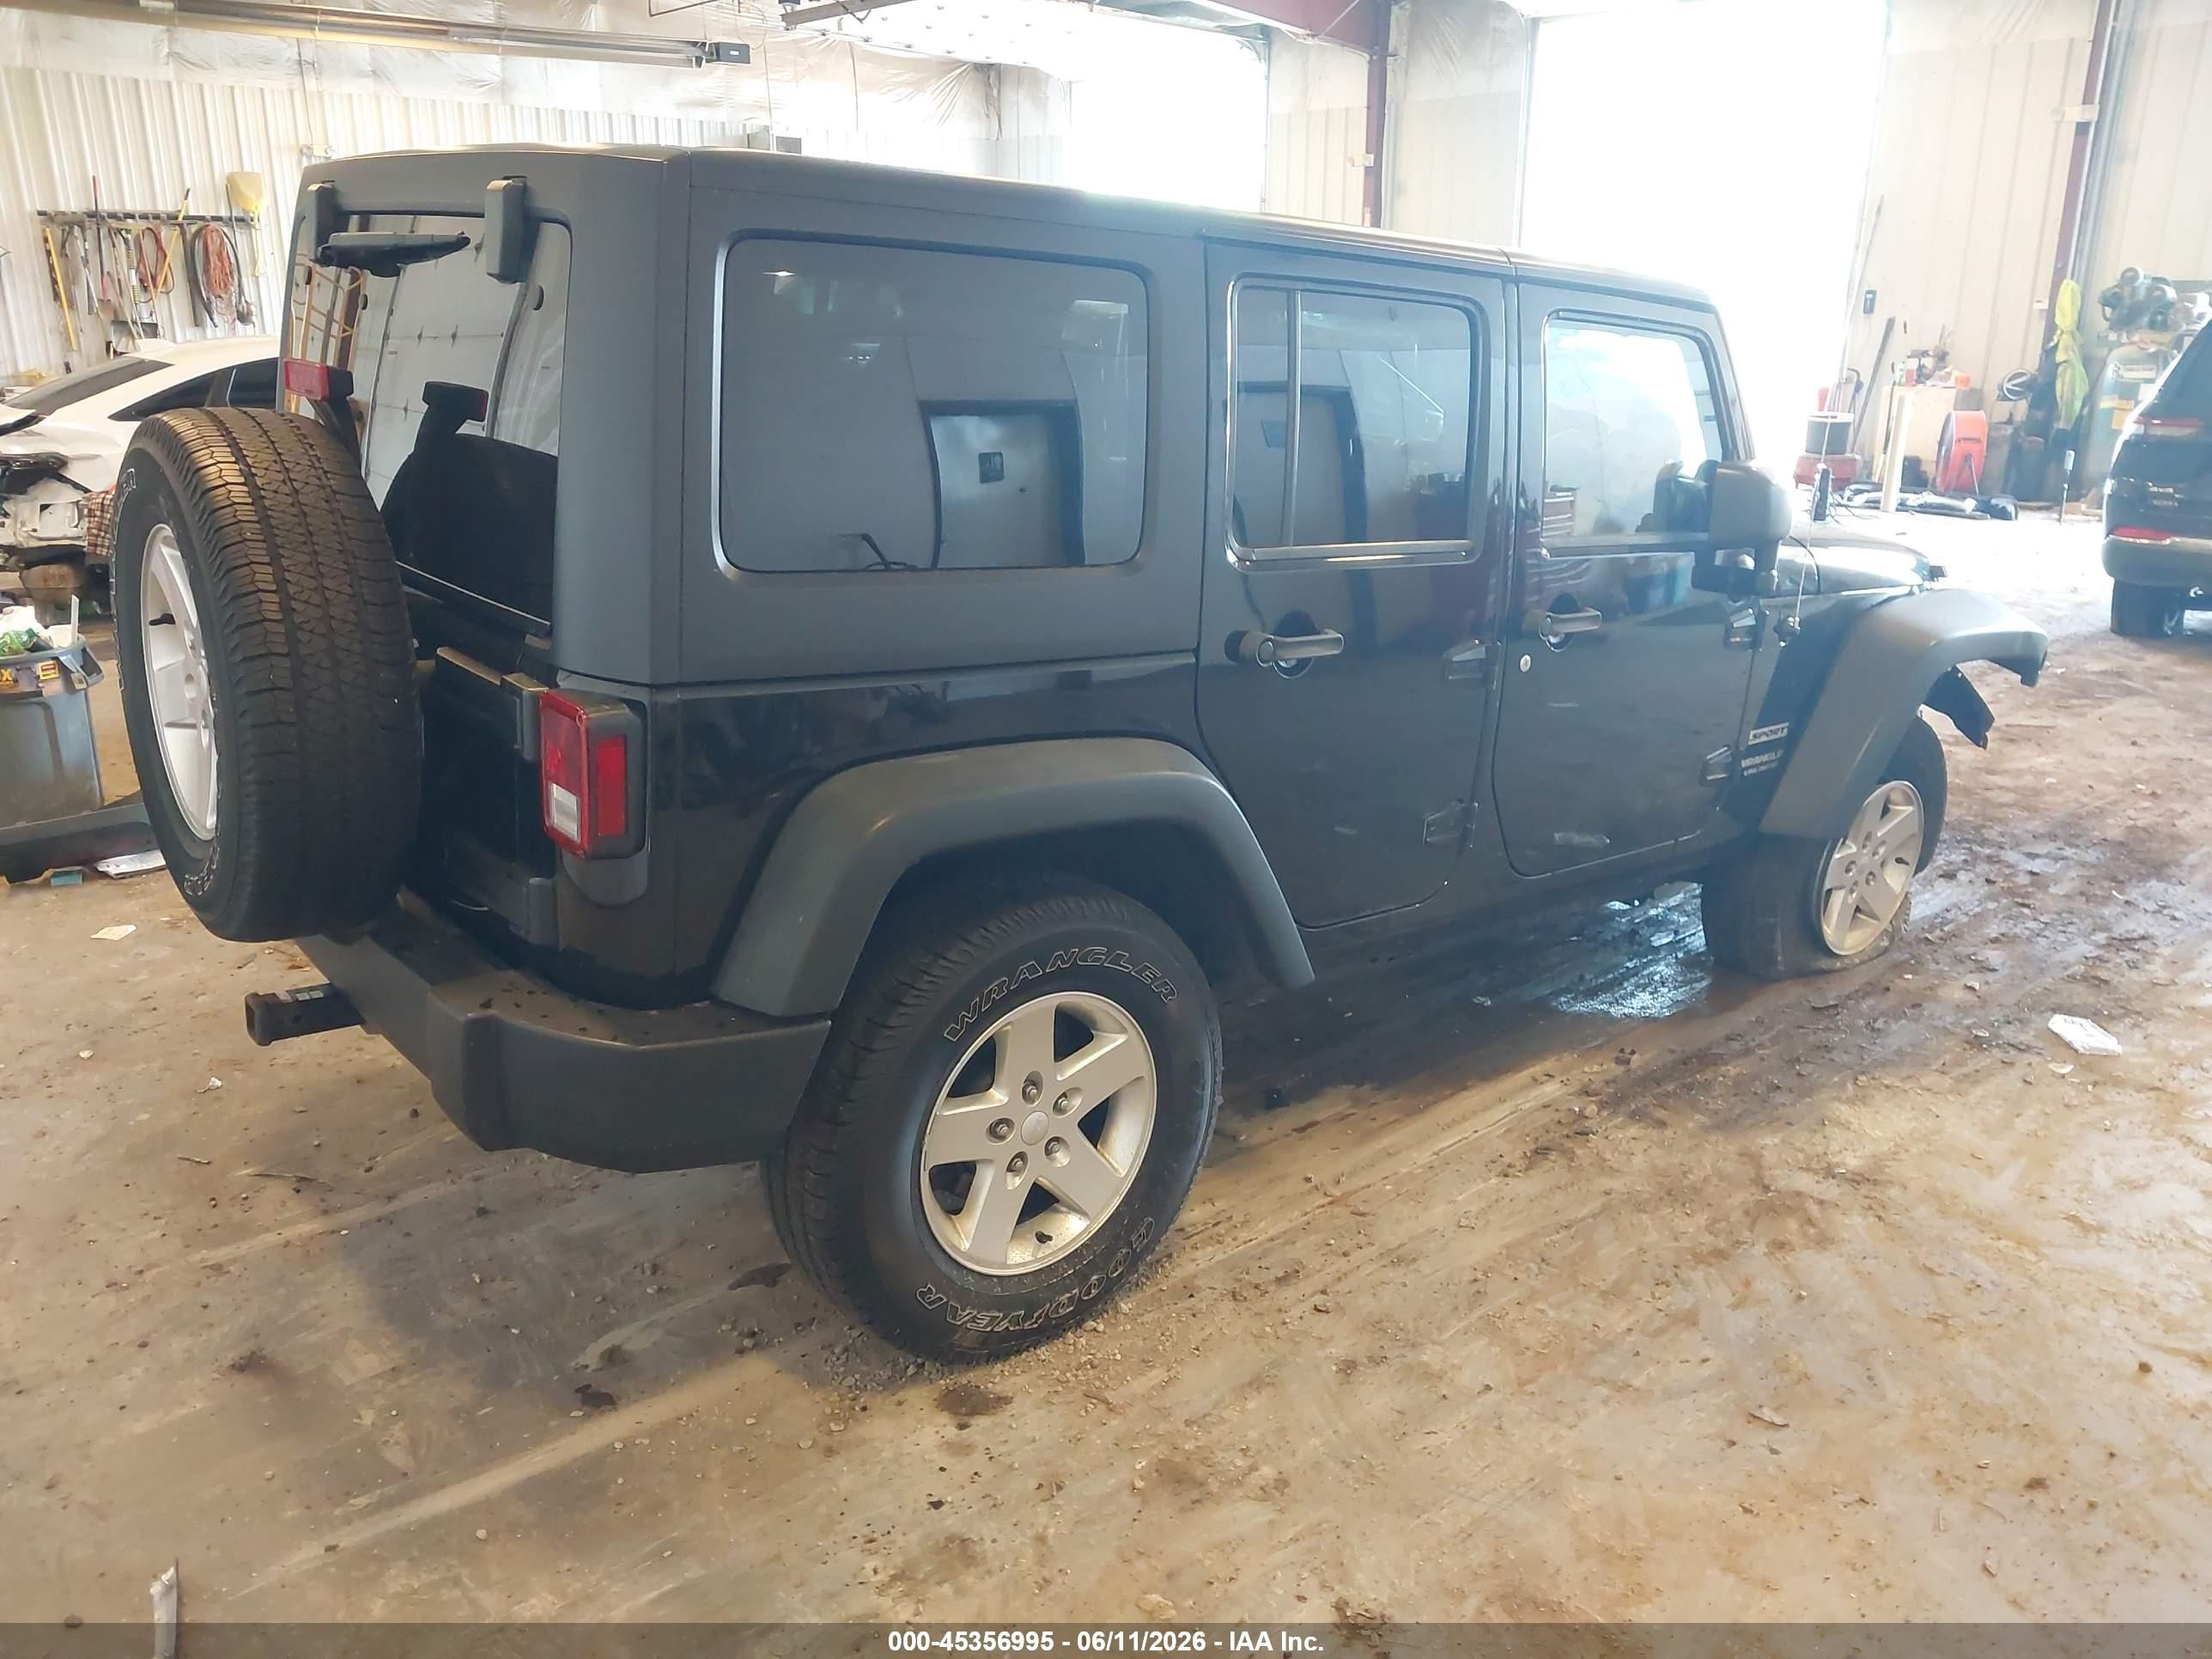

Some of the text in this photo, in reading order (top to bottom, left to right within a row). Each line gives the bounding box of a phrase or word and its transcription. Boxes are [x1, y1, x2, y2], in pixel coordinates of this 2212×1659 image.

[1750, 726, 1786, 739] SPORT
[944, 946, 1177, 1042] WRANGLER
[916, 1217, 1154, 1331] GOODYEAR
